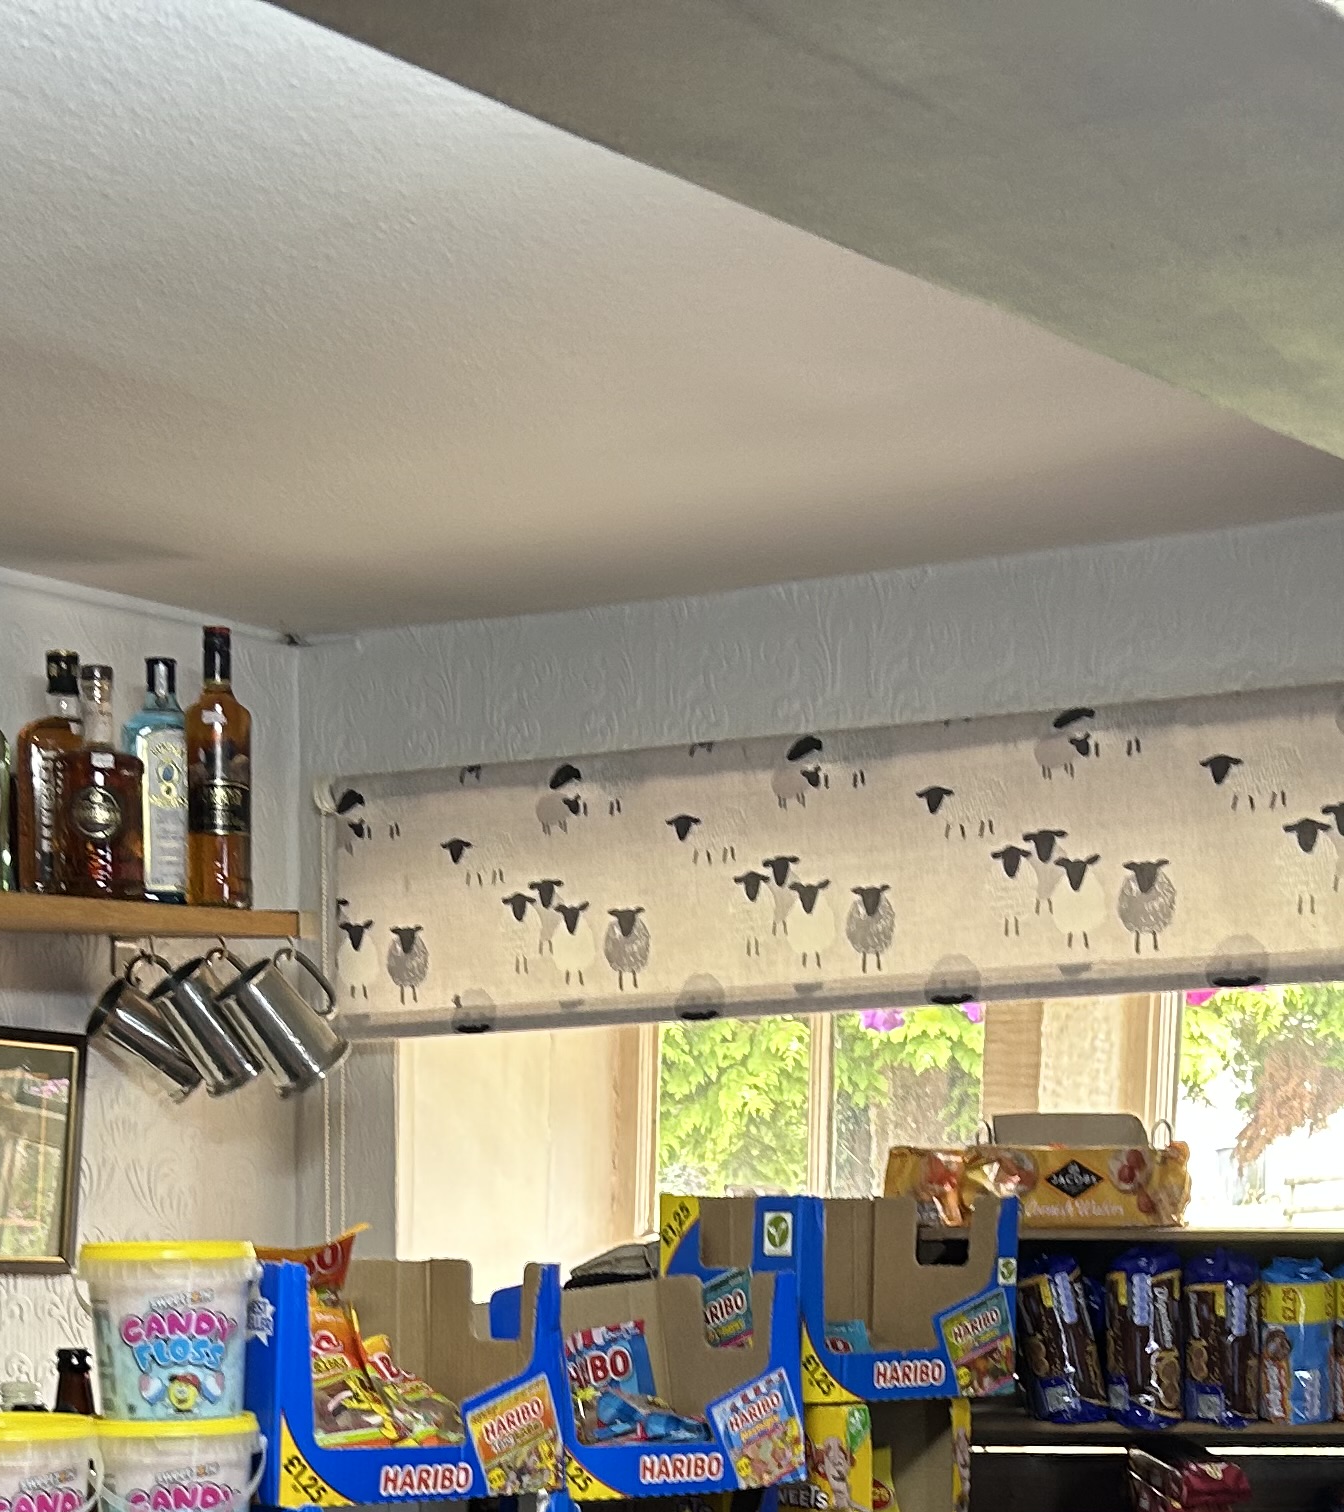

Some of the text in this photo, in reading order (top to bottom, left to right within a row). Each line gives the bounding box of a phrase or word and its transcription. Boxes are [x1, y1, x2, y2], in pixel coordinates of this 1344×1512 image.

[120, 1308, 237, 1347] CANDY
[133, 1336, 226, 1373] FLOSS
[875, 1358, 947, 1389] HARIBO
[483, 1397, 545, 1441] HARIBO
[728, 1392, 782, 1434] HARIBO
[380, 1462, 473, 1496] HARIBO
[639, 1452, 724, 1485] HARIBO
